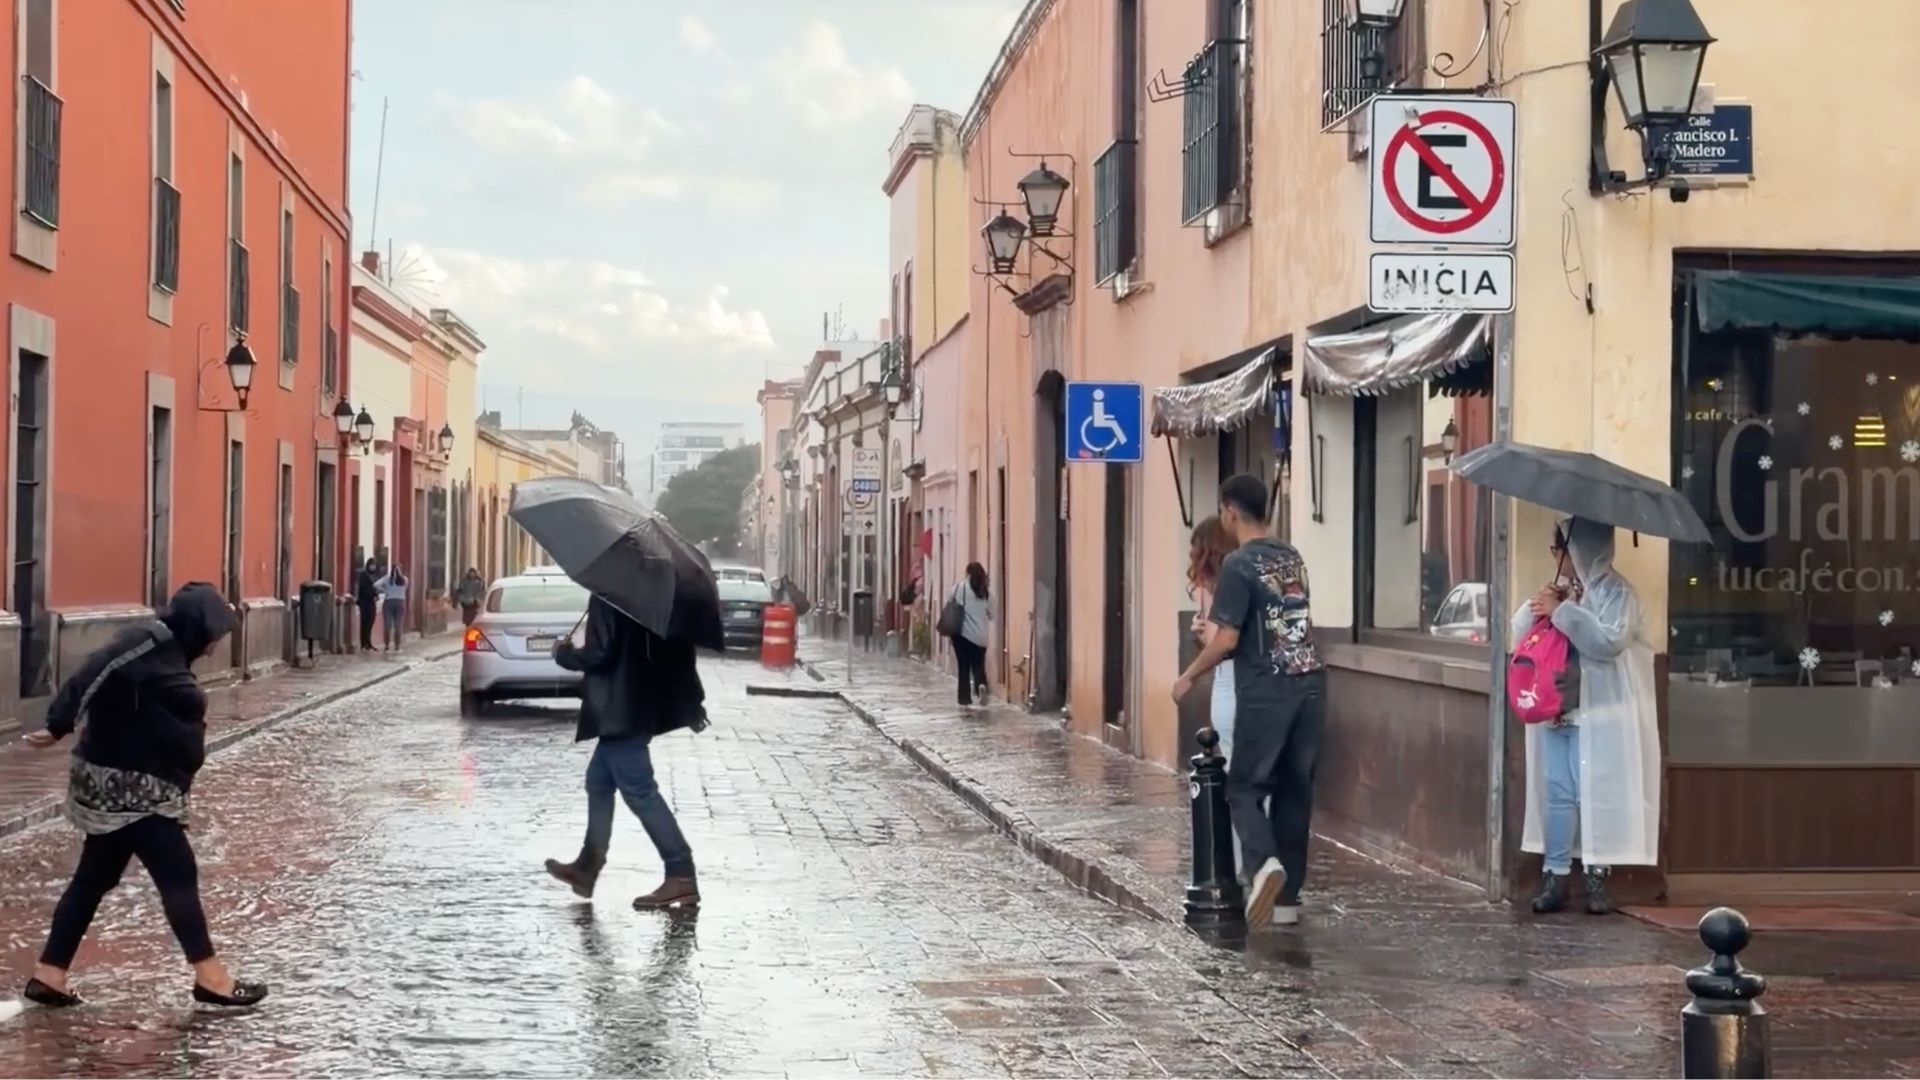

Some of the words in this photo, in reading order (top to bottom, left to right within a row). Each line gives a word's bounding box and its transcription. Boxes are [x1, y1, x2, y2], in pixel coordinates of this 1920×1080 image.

[1688, 116, 1712, 127] Calle
[1417, 134, 1468, 209] E
[1384, 269, 1498, 296] INICIA
